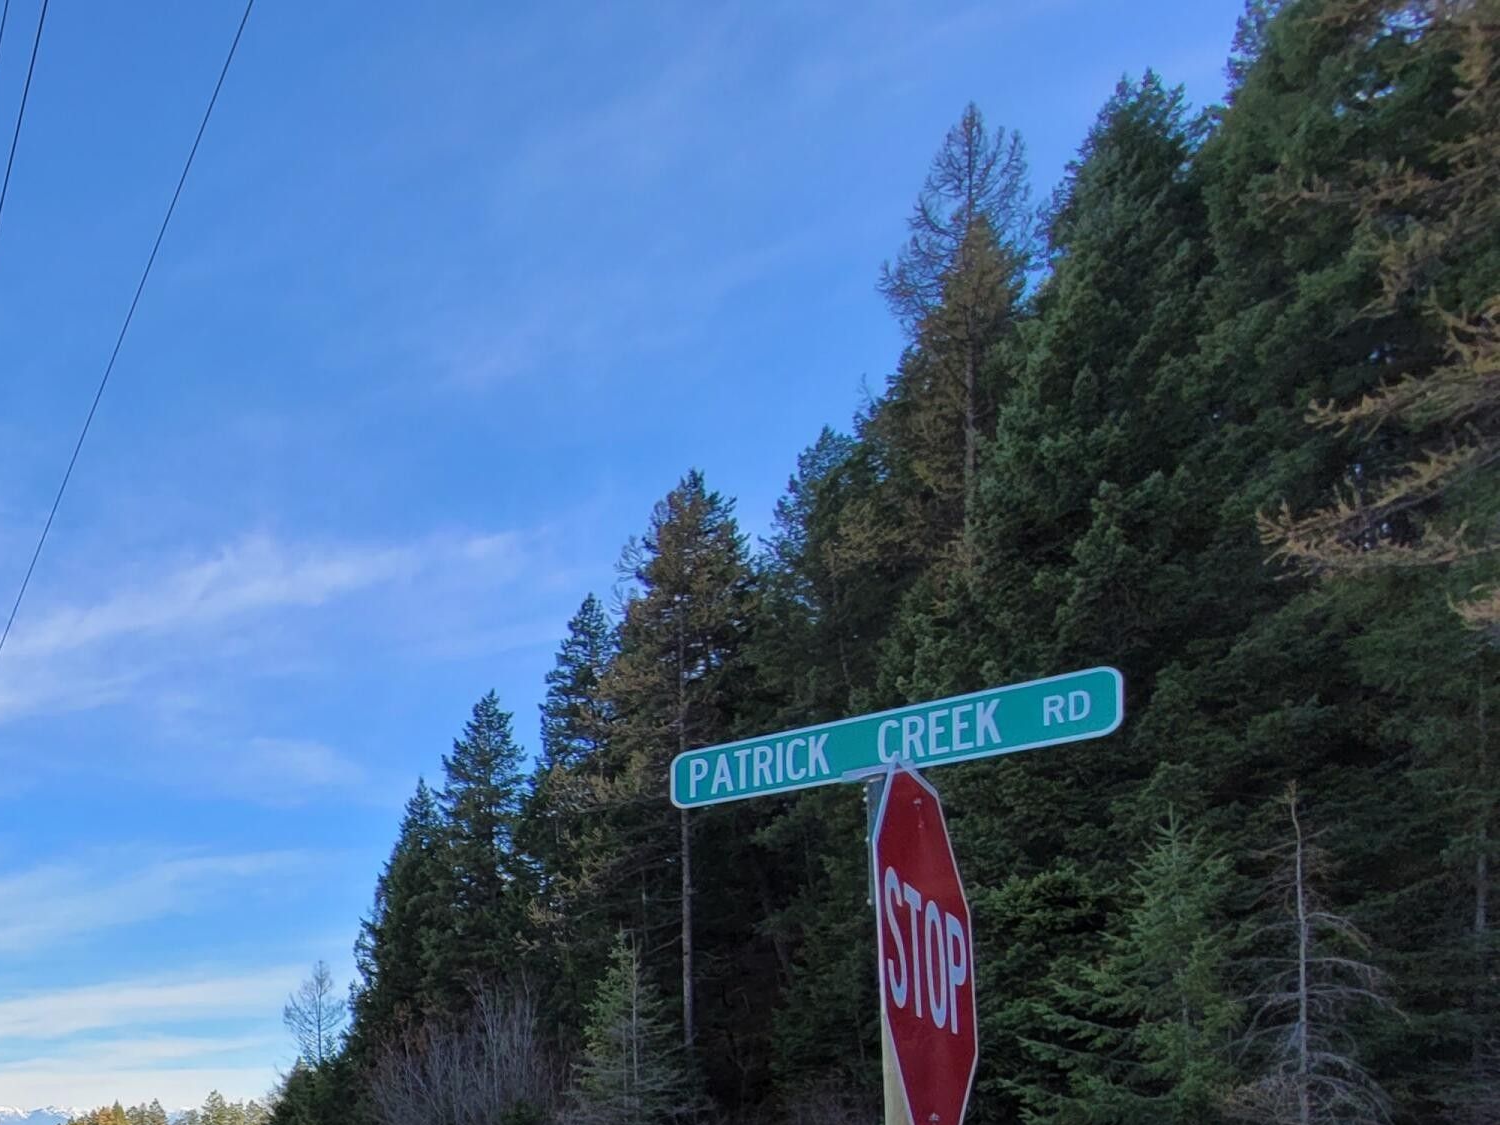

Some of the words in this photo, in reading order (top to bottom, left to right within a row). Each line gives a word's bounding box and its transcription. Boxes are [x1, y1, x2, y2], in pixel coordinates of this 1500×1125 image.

[689, 733, 830, 798] PATRICK
[878, 698, 1001, 763] CREEK
[1043, 690, 1092, 726] RD
[885, 866, 967, 1034] STOP
